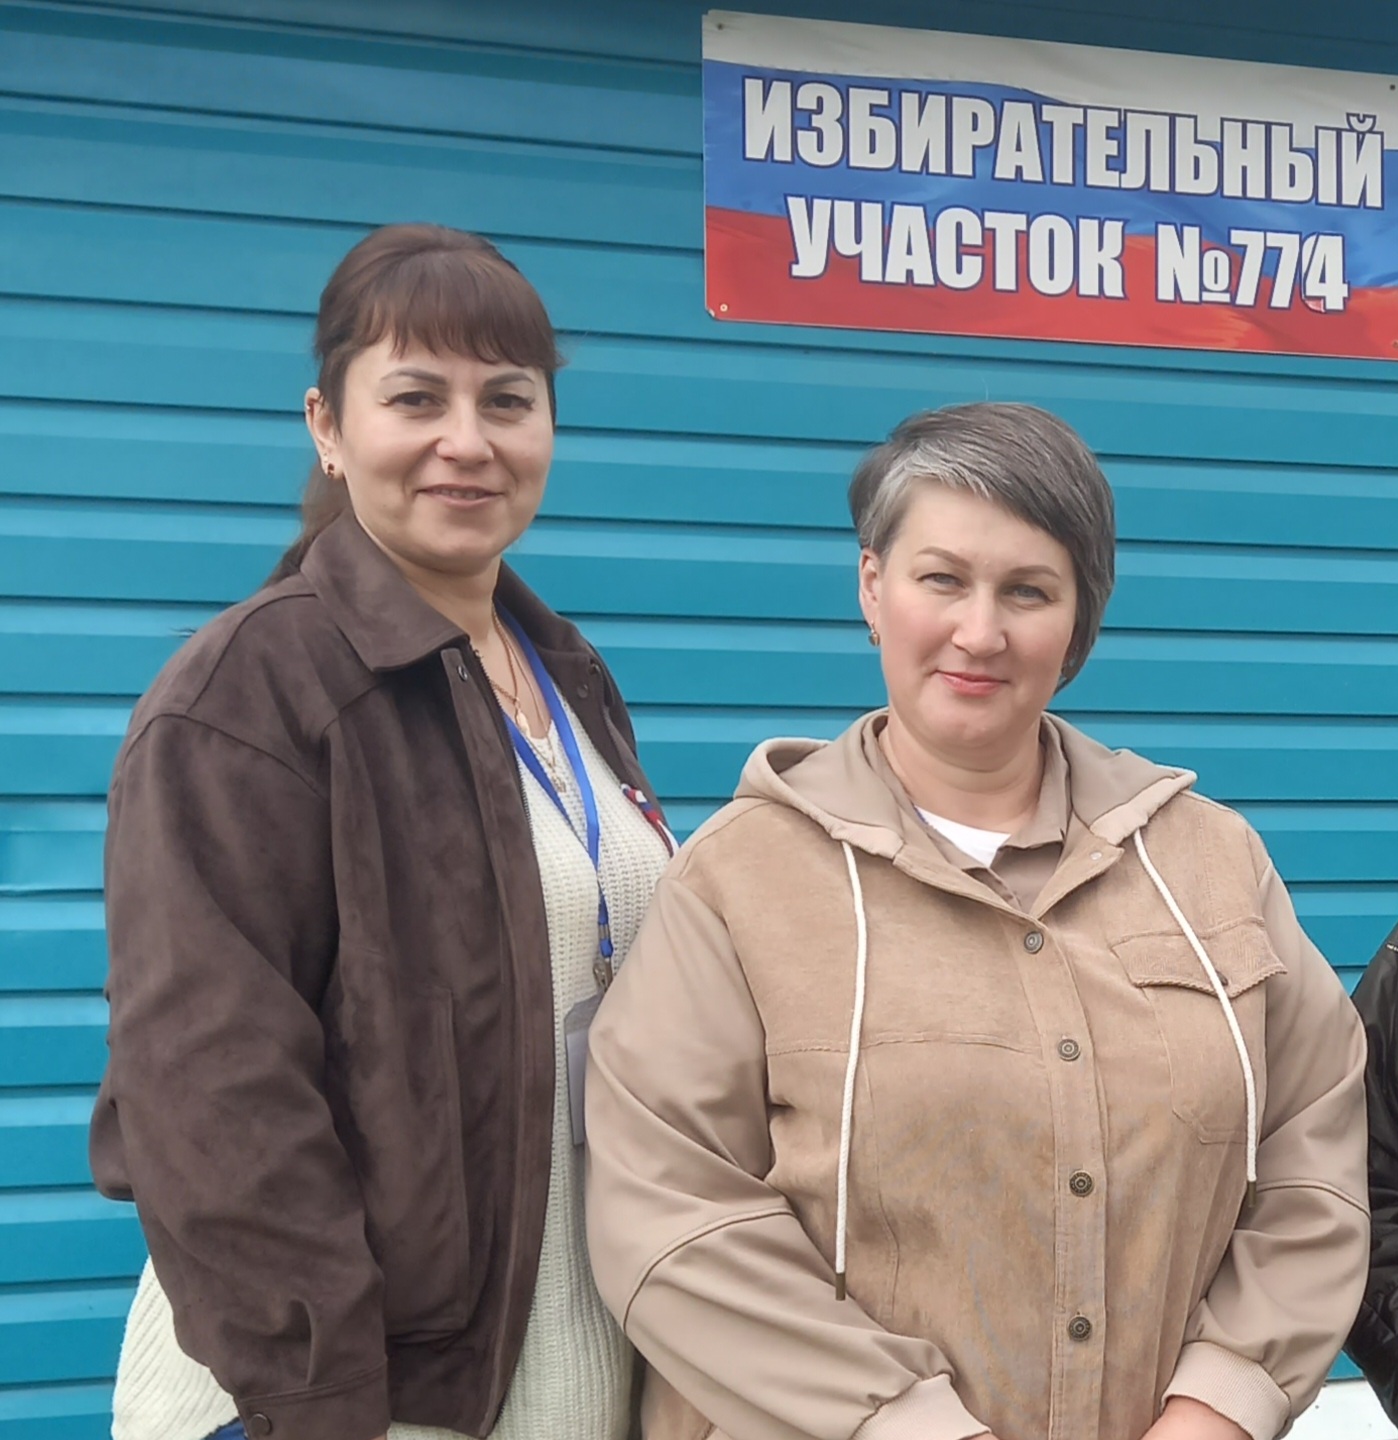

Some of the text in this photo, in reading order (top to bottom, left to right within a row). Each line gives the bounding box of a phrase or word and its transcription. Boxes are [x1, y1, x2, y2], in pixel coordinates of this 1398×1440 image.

[741, 75, 1386, 208] ИЗБИРАТЕЛЬНЫЙ
[786, 194, 1350, 311] УЧАСТОК №774
